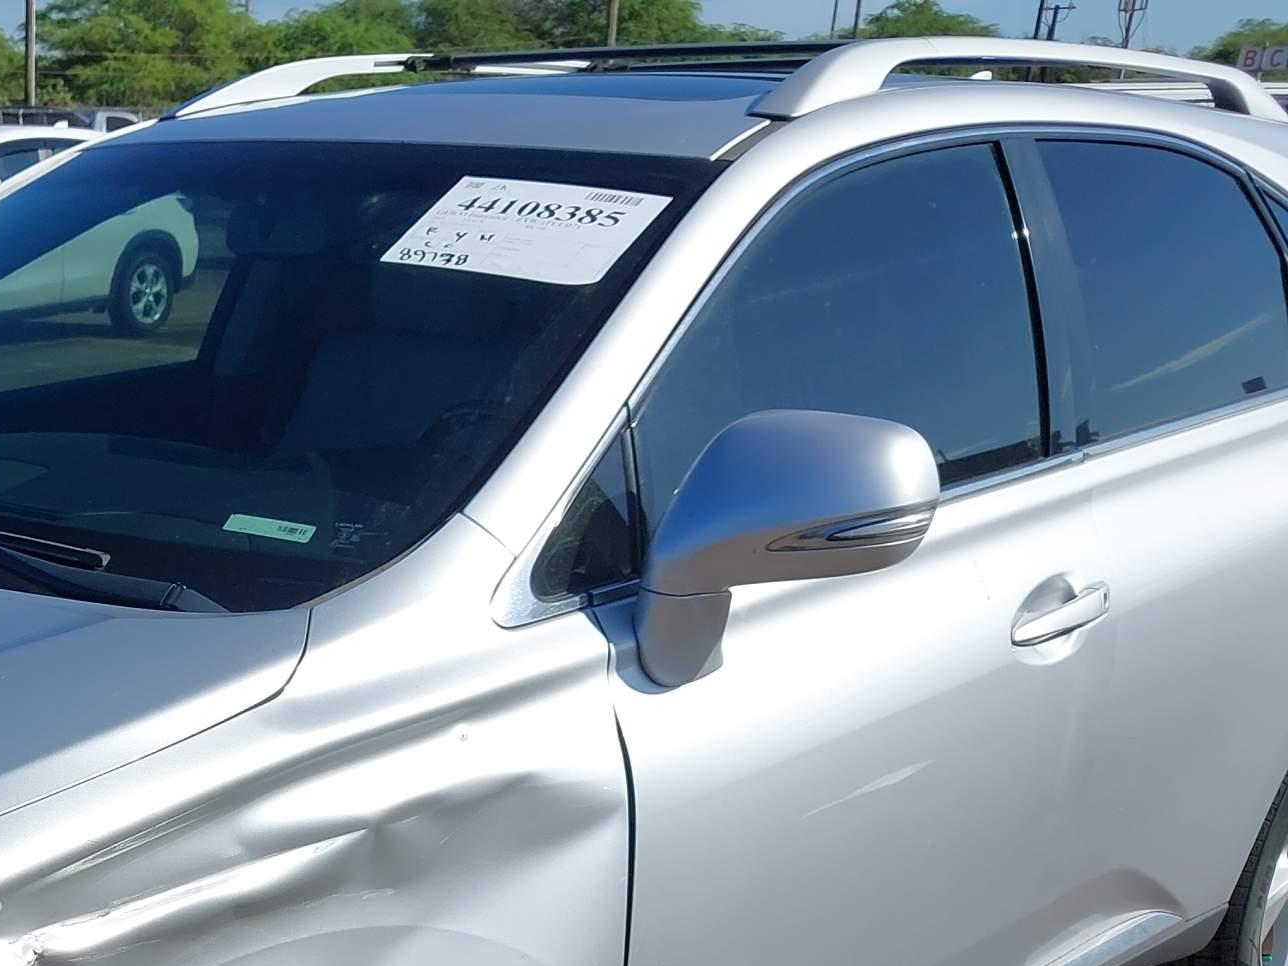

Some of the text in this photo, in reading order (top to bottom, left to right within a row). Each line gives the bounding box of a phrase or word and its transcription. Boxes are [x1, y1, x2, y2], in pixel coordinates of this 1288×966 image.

[1243, 49, 1284, 67] B C
[457, 195, 627, 228] 44108385
